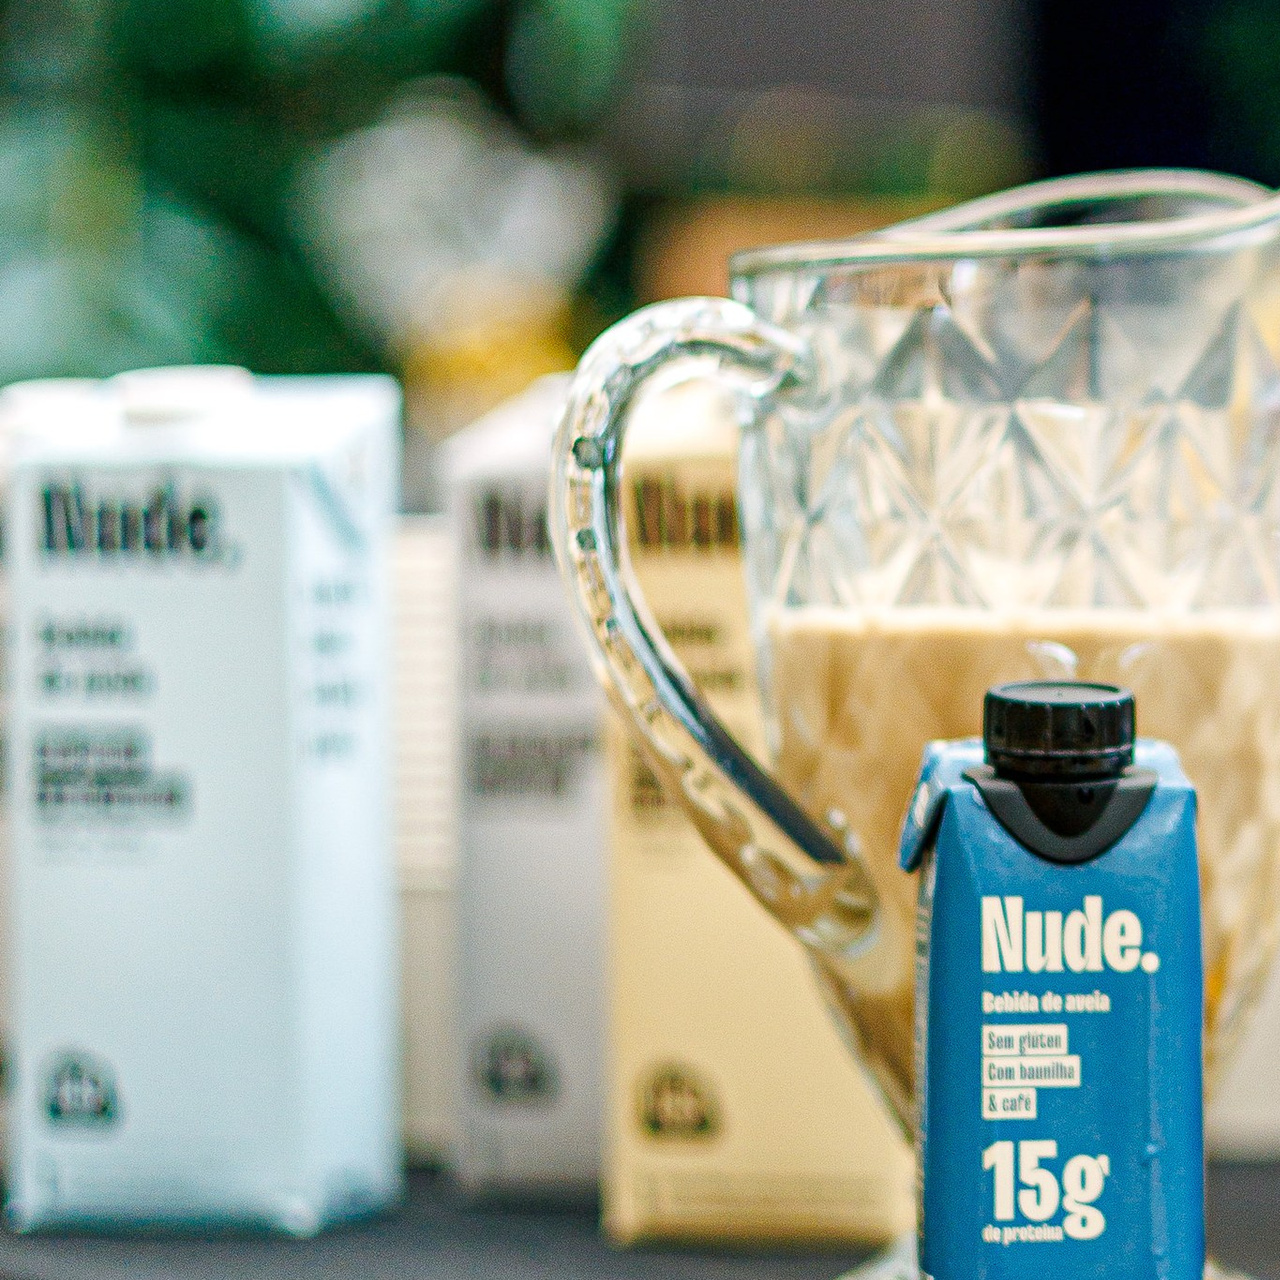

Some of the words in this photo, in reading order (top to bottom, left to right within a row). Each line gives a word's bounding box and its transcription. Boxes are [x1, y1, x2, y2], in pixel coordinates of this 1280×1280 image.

[982, 895, 1160, 974] Nude.
[982, 991, 1040, 1013] Bebida
[1041, 990, 1062, 1012] de
[1065, 990, 1110, 1012] aveia
[988, 1031, 1014, 1050] Sem
[988, 1062, 1015, 1081] Com
[1020, 1062, 1075, 1080] baunilha
[982, 1140, 1110, 1240] 15g
[982, 1224, 1000, 1242] de
